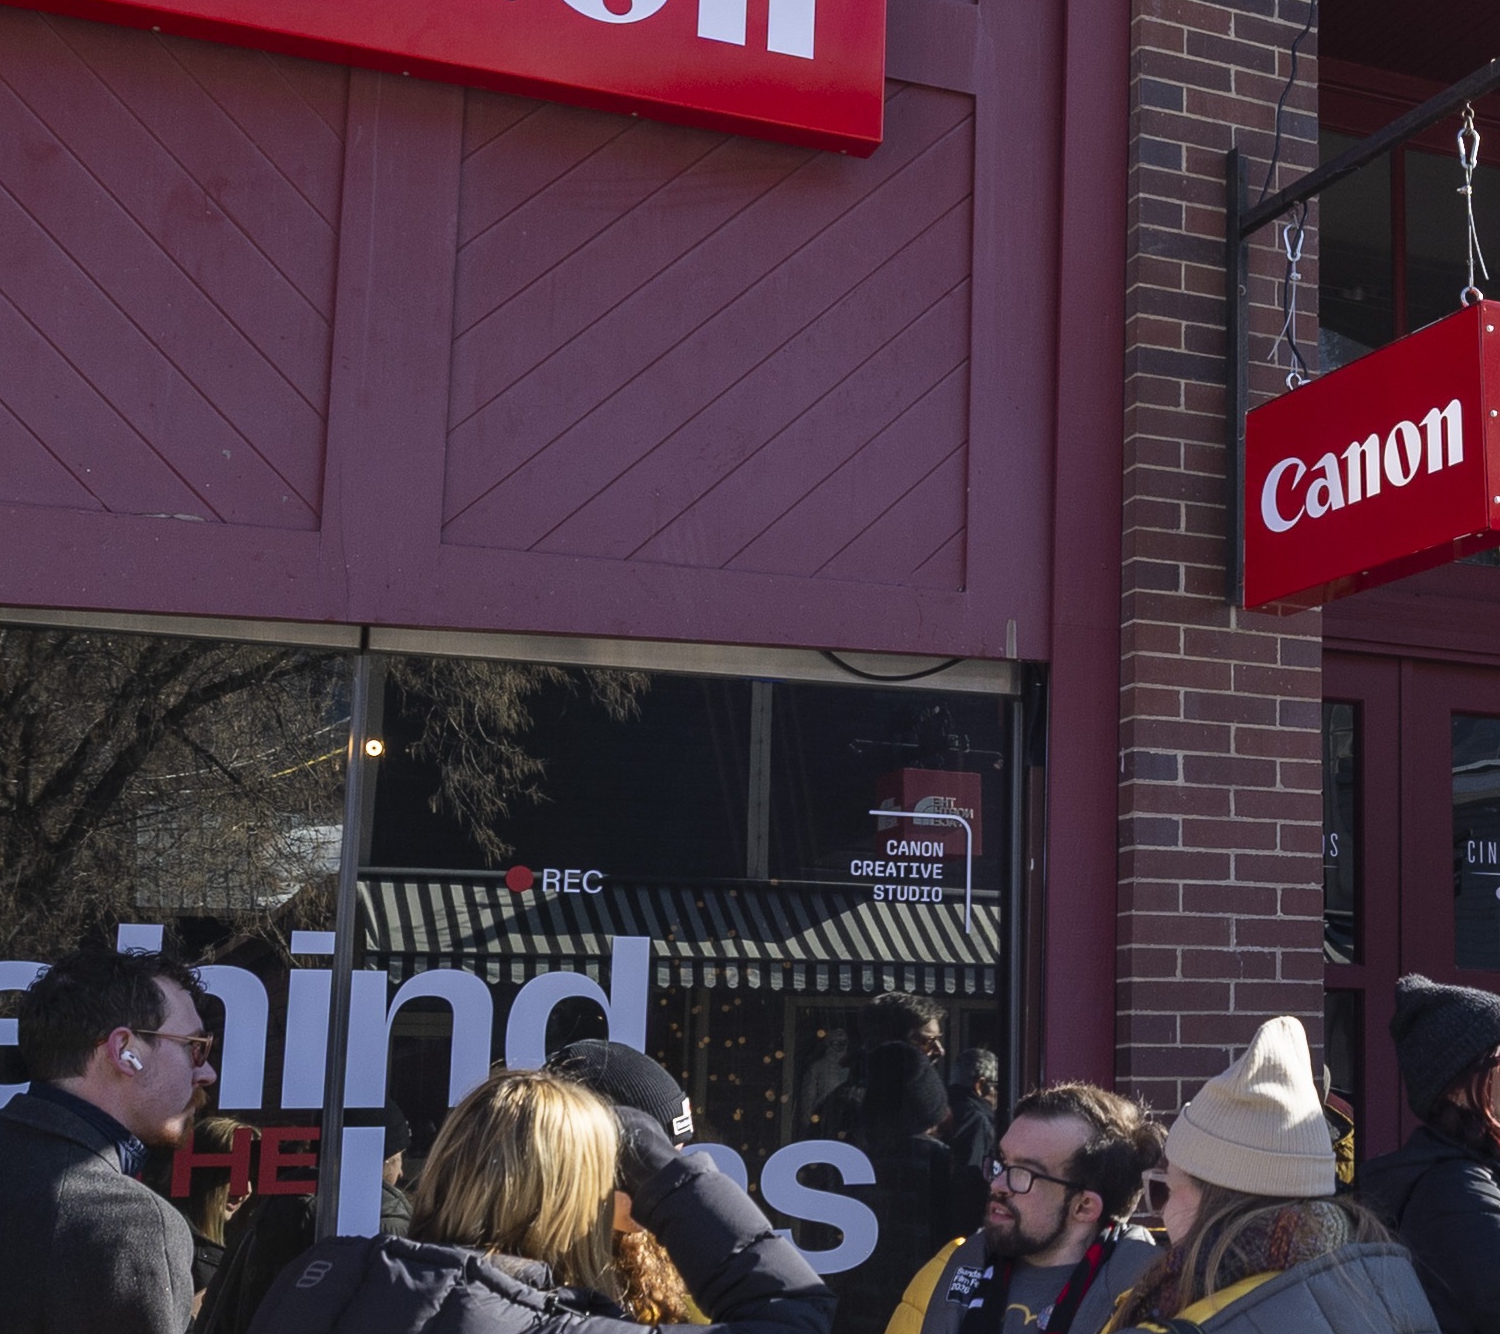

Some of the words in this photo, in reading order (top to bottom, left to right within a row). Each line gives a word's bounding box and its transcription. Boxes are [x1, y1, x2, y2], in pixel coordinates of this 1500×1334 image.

[1260, 398, 1464, 534] Canon
[886, 839, 944, 858] CANON
[850, 859, 944, 879] CREATIVE
[542, 868, 604, 894] REC
[873, 884, 943, 903] STUDIO
[169, 1126, 320, 1198] HE
[956, 1267, 982, 1279] Sunda
